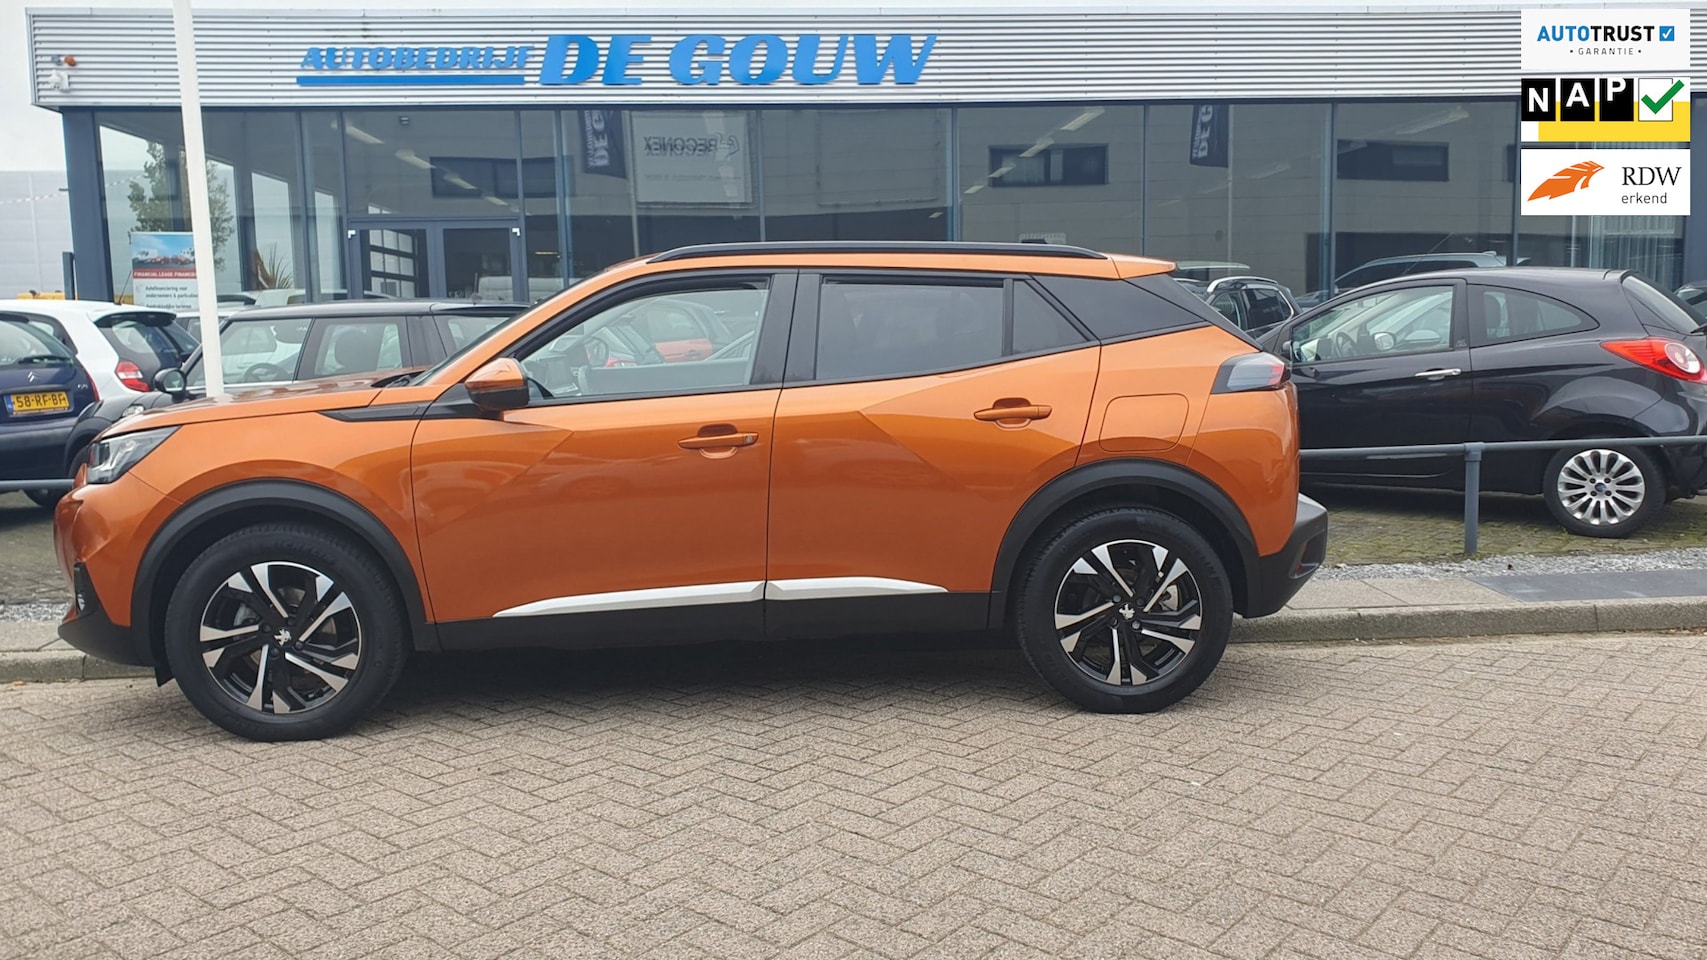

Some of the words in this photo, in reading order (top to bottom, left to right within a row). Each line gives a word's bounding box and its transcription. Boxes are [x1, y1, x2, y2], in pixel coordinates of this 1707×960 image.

[299, 45, 536, 71] AUTOBEDRIJF
[538, 34, 654, 87] DE
[667, 34, 940, 87] GOUW
